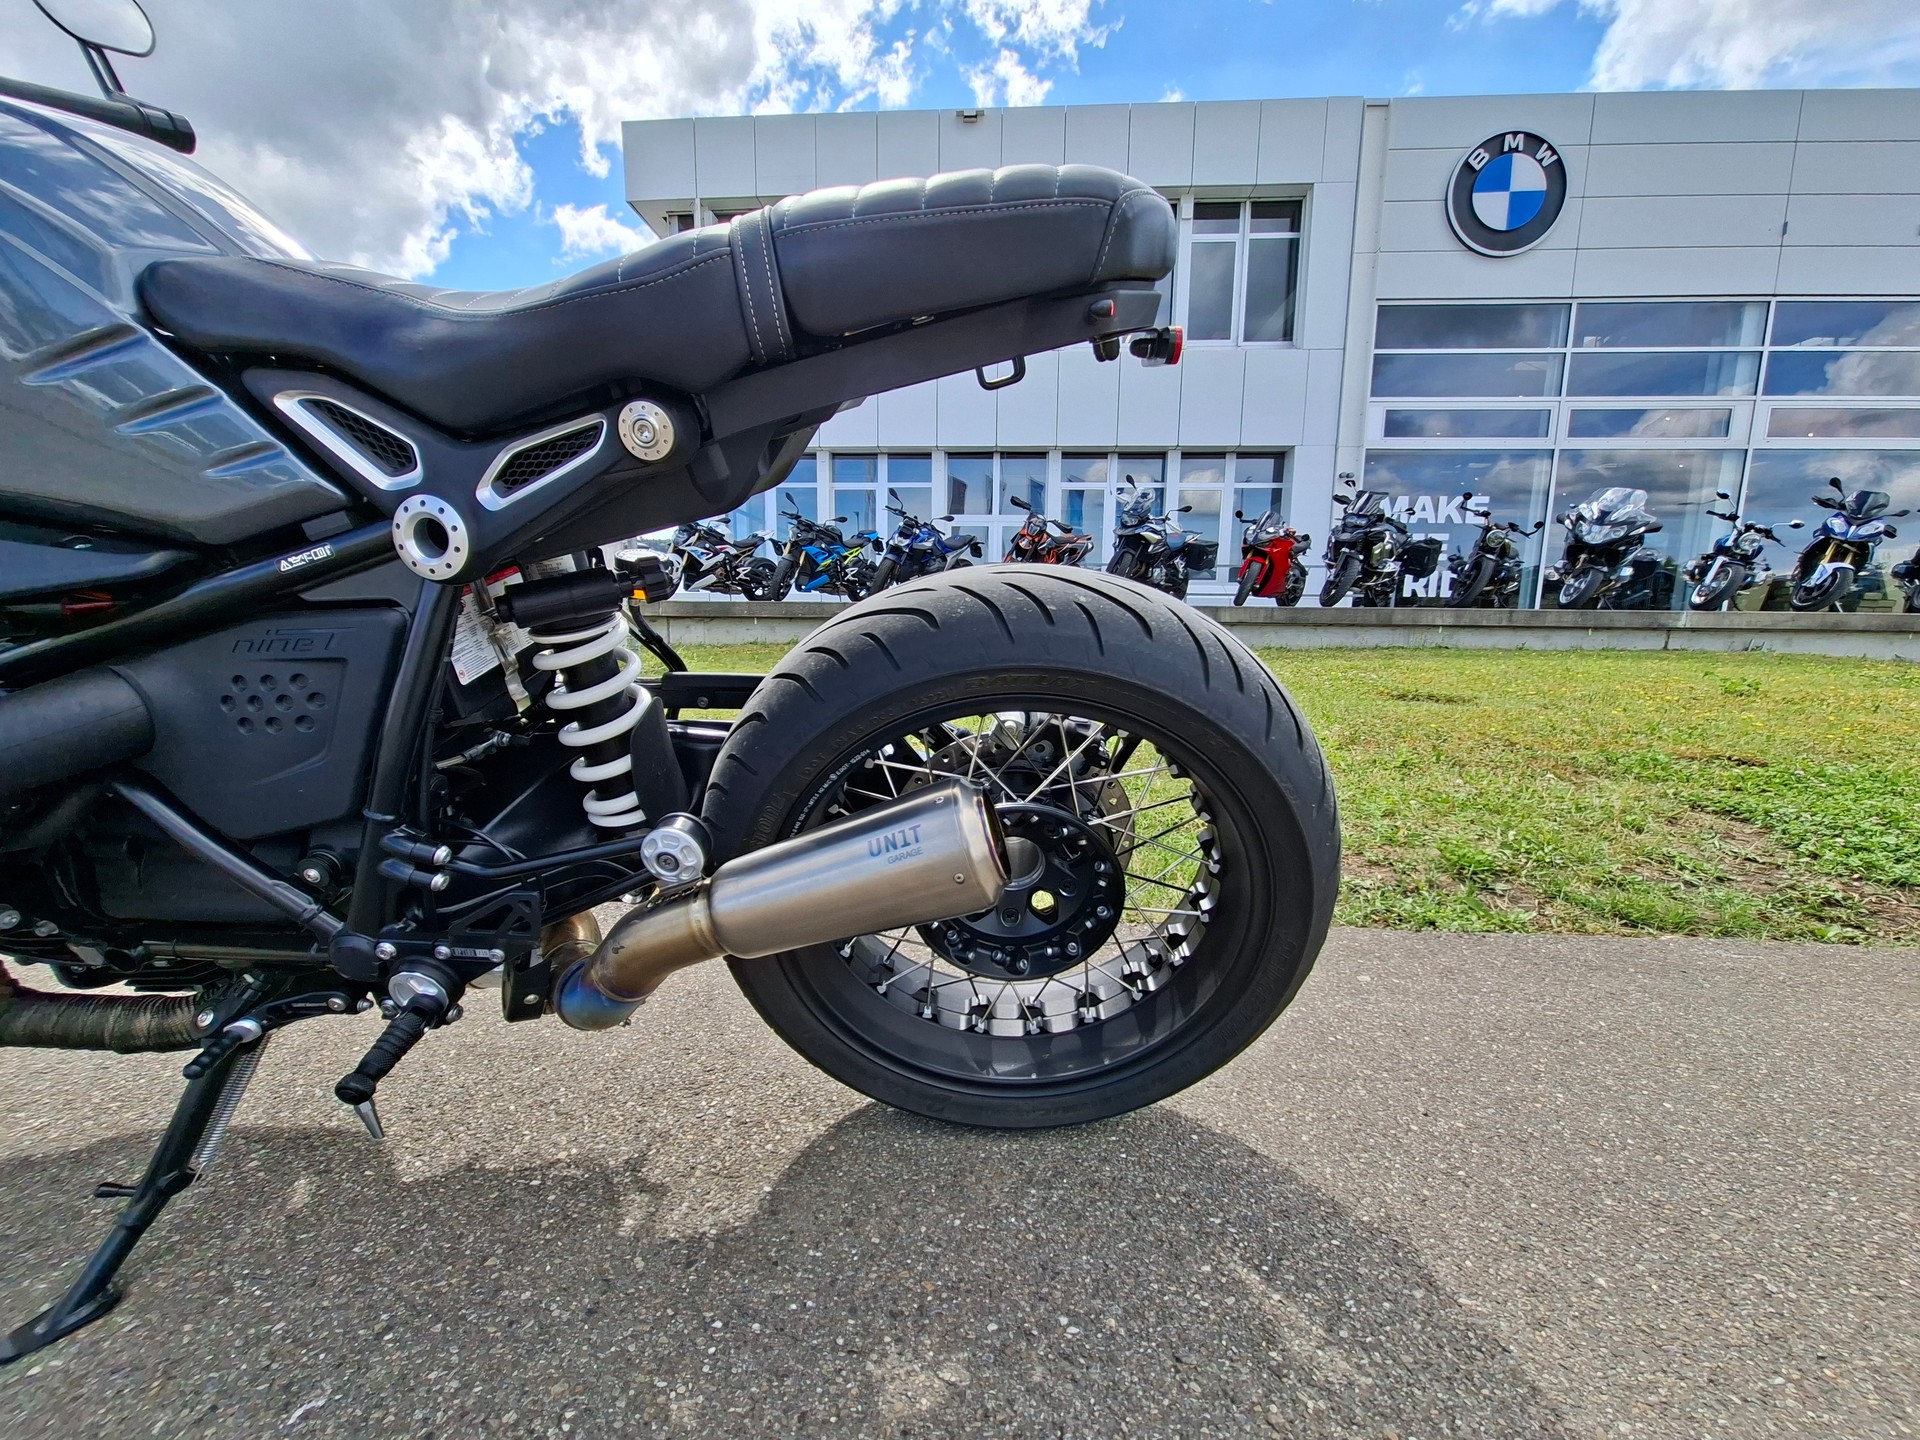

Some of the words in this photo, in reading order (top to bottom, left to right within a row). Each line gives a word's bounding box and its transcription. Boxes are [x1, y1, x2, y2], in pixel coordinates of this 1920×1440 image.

[1467, 133, 1558, 171] BMW
[1381, 495, 1490, 524] MAKE
[887, 846, 924, 865] GARAGE
